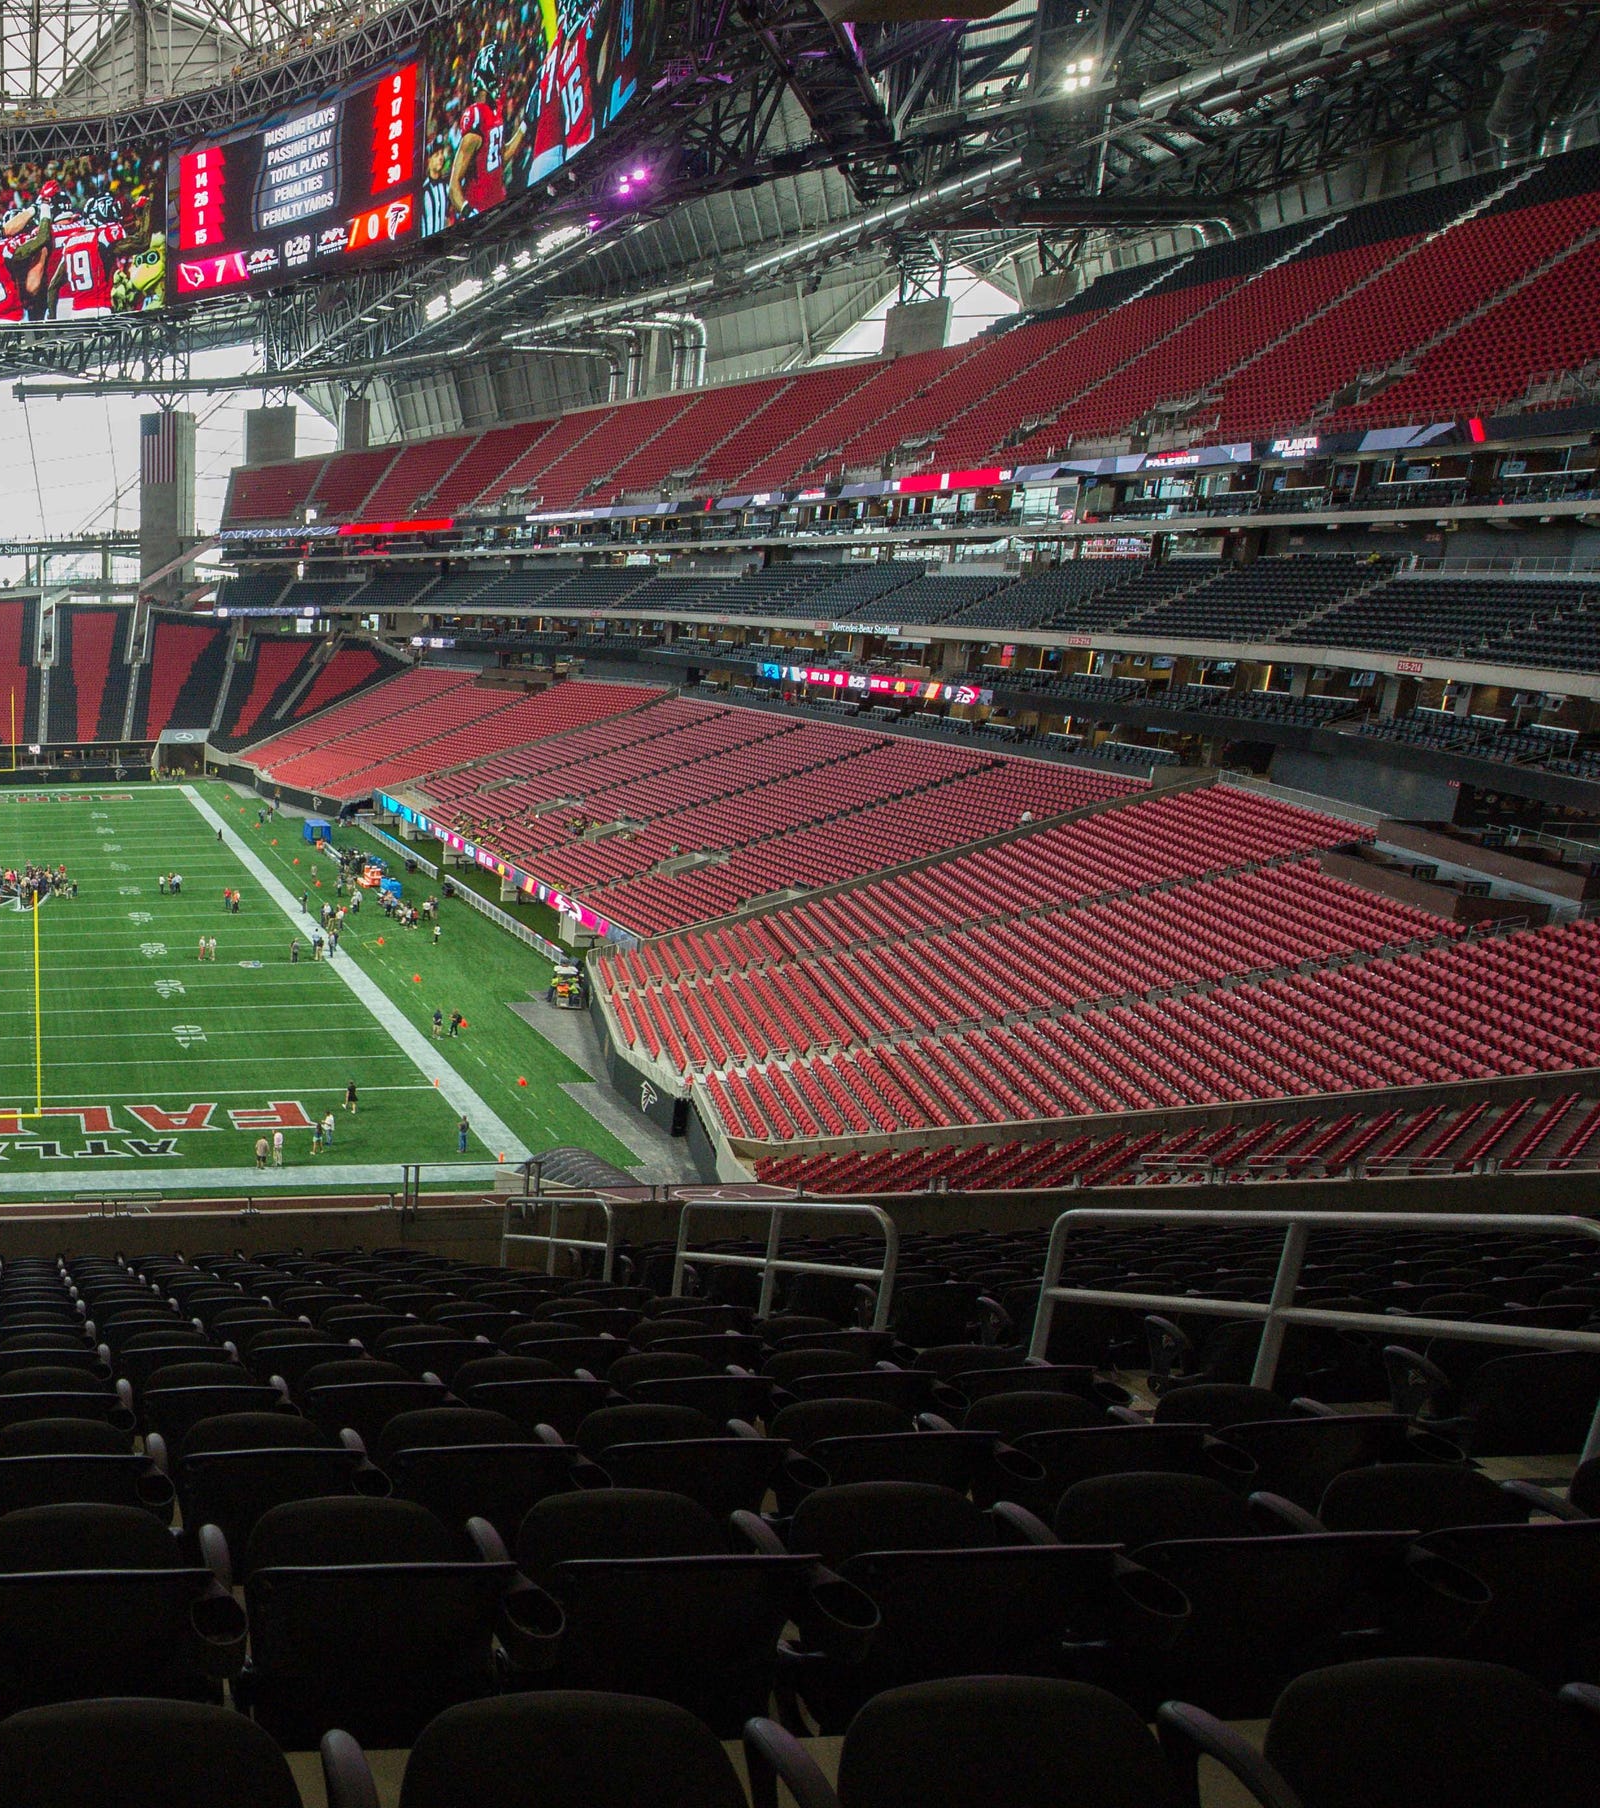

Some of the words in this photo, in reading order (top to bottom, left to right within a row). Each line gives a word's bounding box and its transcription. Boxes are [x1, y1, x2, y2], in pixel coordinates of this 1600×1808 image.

[391, 75, 402, 93] 9
[391, 99, 402, 117] 17
[560, 66, 584, 135] 16
[264, 118, 305, 147] RUSHING
[306, 108, 336, 133] PLAYS
[267, 139, 308, 166] PASSING
[308, 129, 332, 154] PLAY
[391, 143, 398, 160] 3
[196, 153, 207, 169] 11
[270, 163, 299, 185] TOTAL
[300, 152, 329, 175] PLAYS
[195, 173, 208, 188] 14
[387, 164, 401, 184] 30
[274, 174, 324, 203] PENALTIES
[194, 191, 209, 208] 26
[262, 201, 303, 227] PENALTY
[303, 191, 335, 214] YARDS
[197, 210, 204, 225] 1
[367, 214, 379, 240] 0
[195, 228, 207, 245] 15
[284, 234, 311, 258] 0:26
[65, 249, 93, 292] 19
[214, 259, 226, 282] 7
[4, 545, 39, 554] Stadium
[832, 622, 873, 634] Mercedes-Benz
[874, 624, 900, 635] Stadium
[781, 667, 788, 678] 7
[848, 675, 866, 688] 0:25
[944, 687, 951, 700] 0
[154, 980, 186, 994] 20
[171, 1025, 207, 1043] 10
